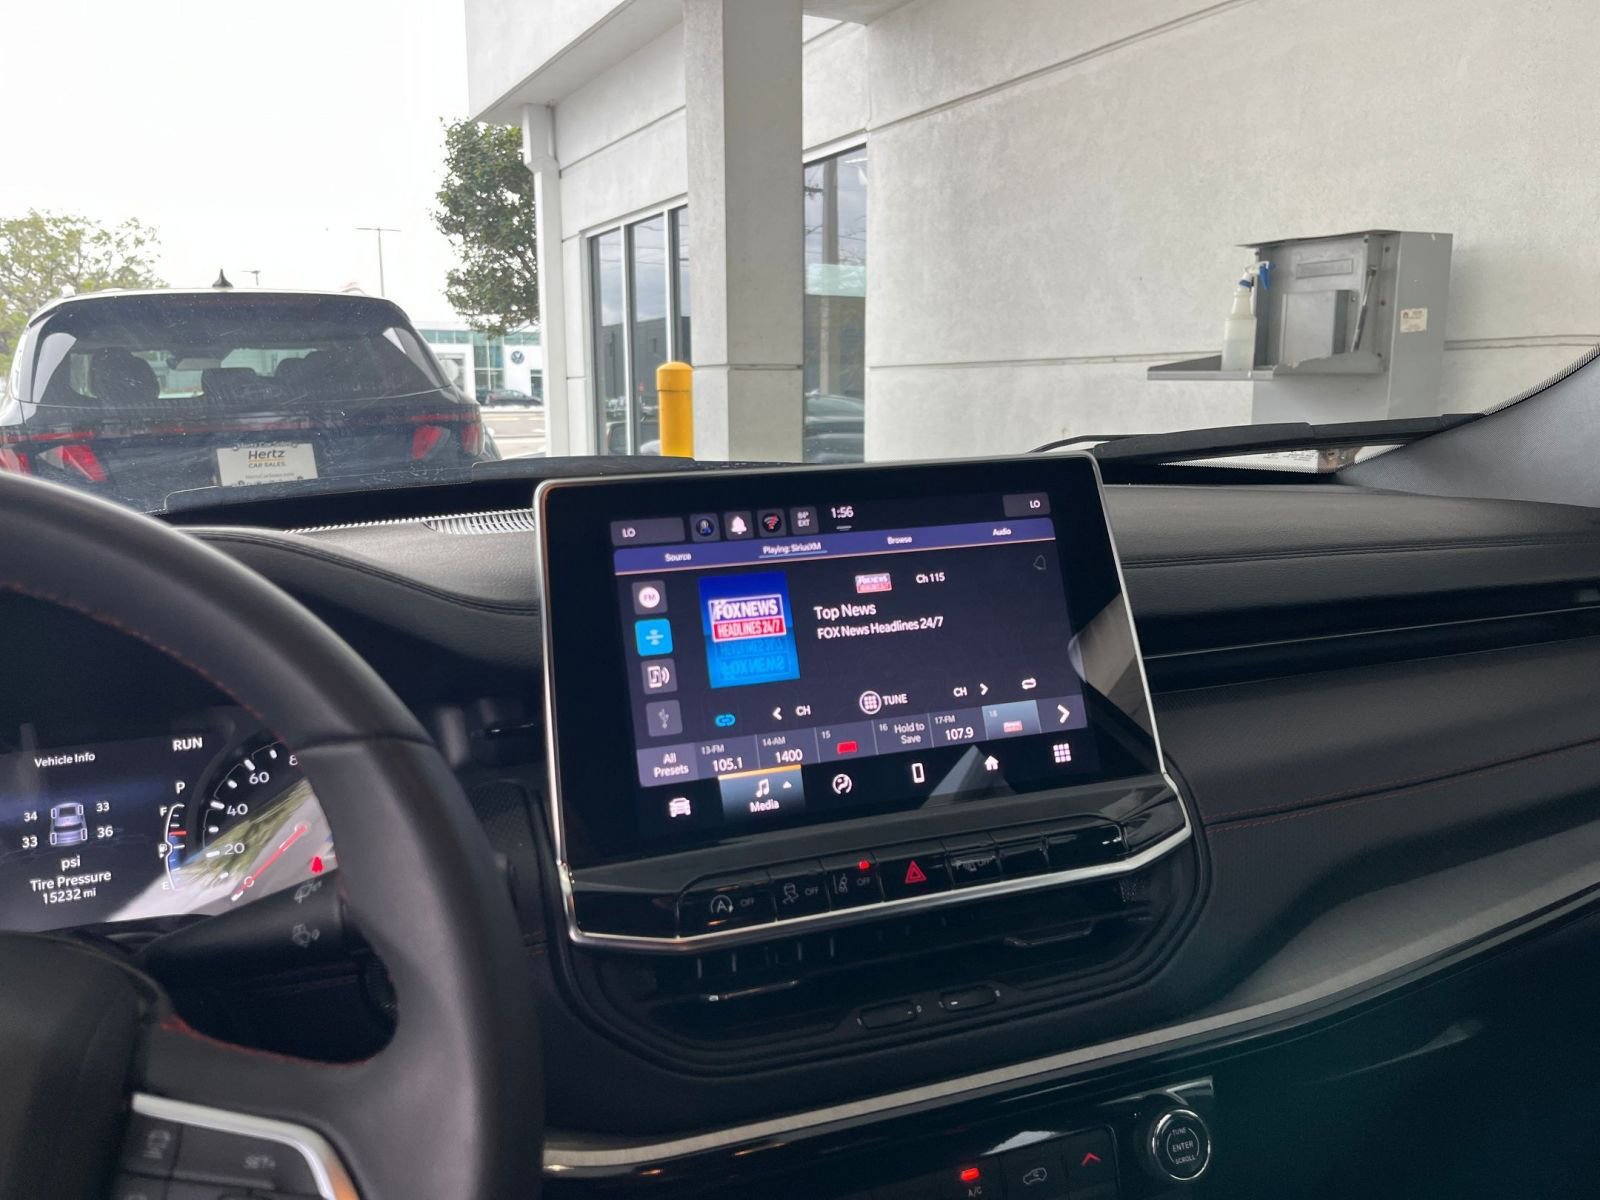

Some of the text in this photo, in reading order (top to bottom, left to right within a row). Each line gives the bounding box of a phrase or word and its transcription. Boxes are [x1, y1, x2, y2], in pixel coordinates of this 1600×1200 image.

[248, 449, 286, 460] Hertz
[1029, 499, 1041, 509] LO
[831, 506, 854, 518] 1:56
[622, 527, 636, 538] LO
[992, 527, 1012, 537] Audio
[887, 535, 912, 545] Browse
[791, 541, 822, 553] SiriusXM
[664, 552, 692, 562] Source
[916, 572, 946, 584] Ch 115
[714, 598, 778, 619] FOX NEWS
[813, 602, 877, 621] Top News
[717, 619, 780, 637] HEADLINES 24/7
[817, 616, 944, 639] FOX News Headlines 24/7
[953, 686, 967, 698] CH
[882, 693, 908, 706] TUNE
[795, 704, 811, 716] CH
[934, 714, 956, 725] 17-FM
[879, 723, 888, 732] 16
[894, 721, 925, 735] Hold to
[945, 726, 974, 741] 107.9
[821, 730, 831, 739] 15
[901, 733, 921, 745] Save
[172, 737, 203, 751] RUN
[762, 736, 786, 747] 14-AM
[34, 751, 96, 768] Vehicle Info
[663, 752, 677, 765] All
[775, 748, 803, 764] 1400
[713, 756, 743, 772] 105.1
[249, 770, 270, 785] 60
[654, 764, 689, 778] Presets
[176, 781, 185, 794] P
[96, 801, 110, 813] 33
[160, 806, 168, 818] F
[227, 802, 249, 817] 40
[750, 799, 780, 813] Media
[23, 810, 38, 822] 34
[96, 826, 114, 839] 36
[21, 836, 38, 849] 33
[224, 842, 245, 855] 20
[61, 855, 81, 871] psi
[30, 870, 112, 892] Tire Pressure
[162, 881, 170, 891] E
[857, 876, 871, 887] OFF
[42, 886, 97, 905] 15232 mi
[1172, 1140, 1194, 1152] ENTER
[1175, 1154, 1196, 1165] SCROLL
[968, 1185, 983, 1198] A/C
